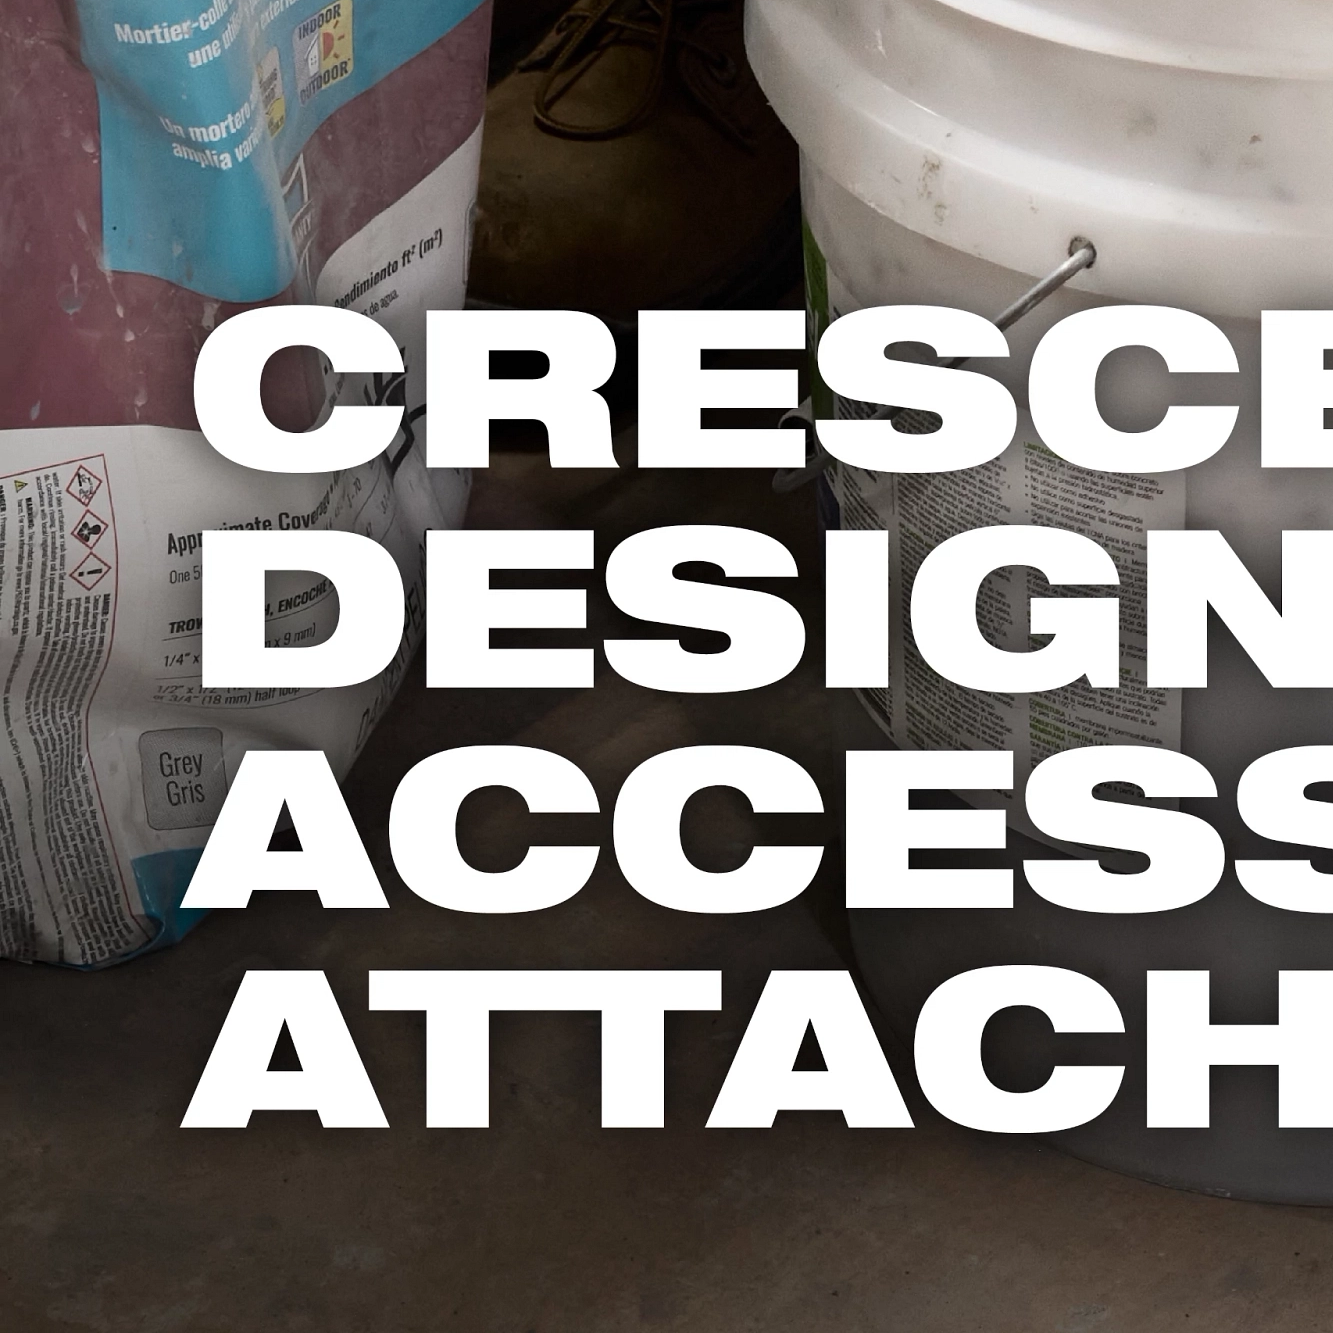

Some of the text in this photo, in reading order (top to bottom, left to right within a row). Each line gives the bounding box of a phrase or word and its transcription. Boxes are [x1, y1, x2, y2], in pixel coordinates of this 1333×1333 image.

[299, 3, 342, 41] INDOOR
[188, 39, 222, 68] une
[188, 101, 251, 142] mortero
[172, 142, 232, 171] amplia
[370, 299, 379, 314] de
[169, 569, 191, 584] One
[159, 751, 204, 782] Grey
[166, 780, 206, 806] Gris
